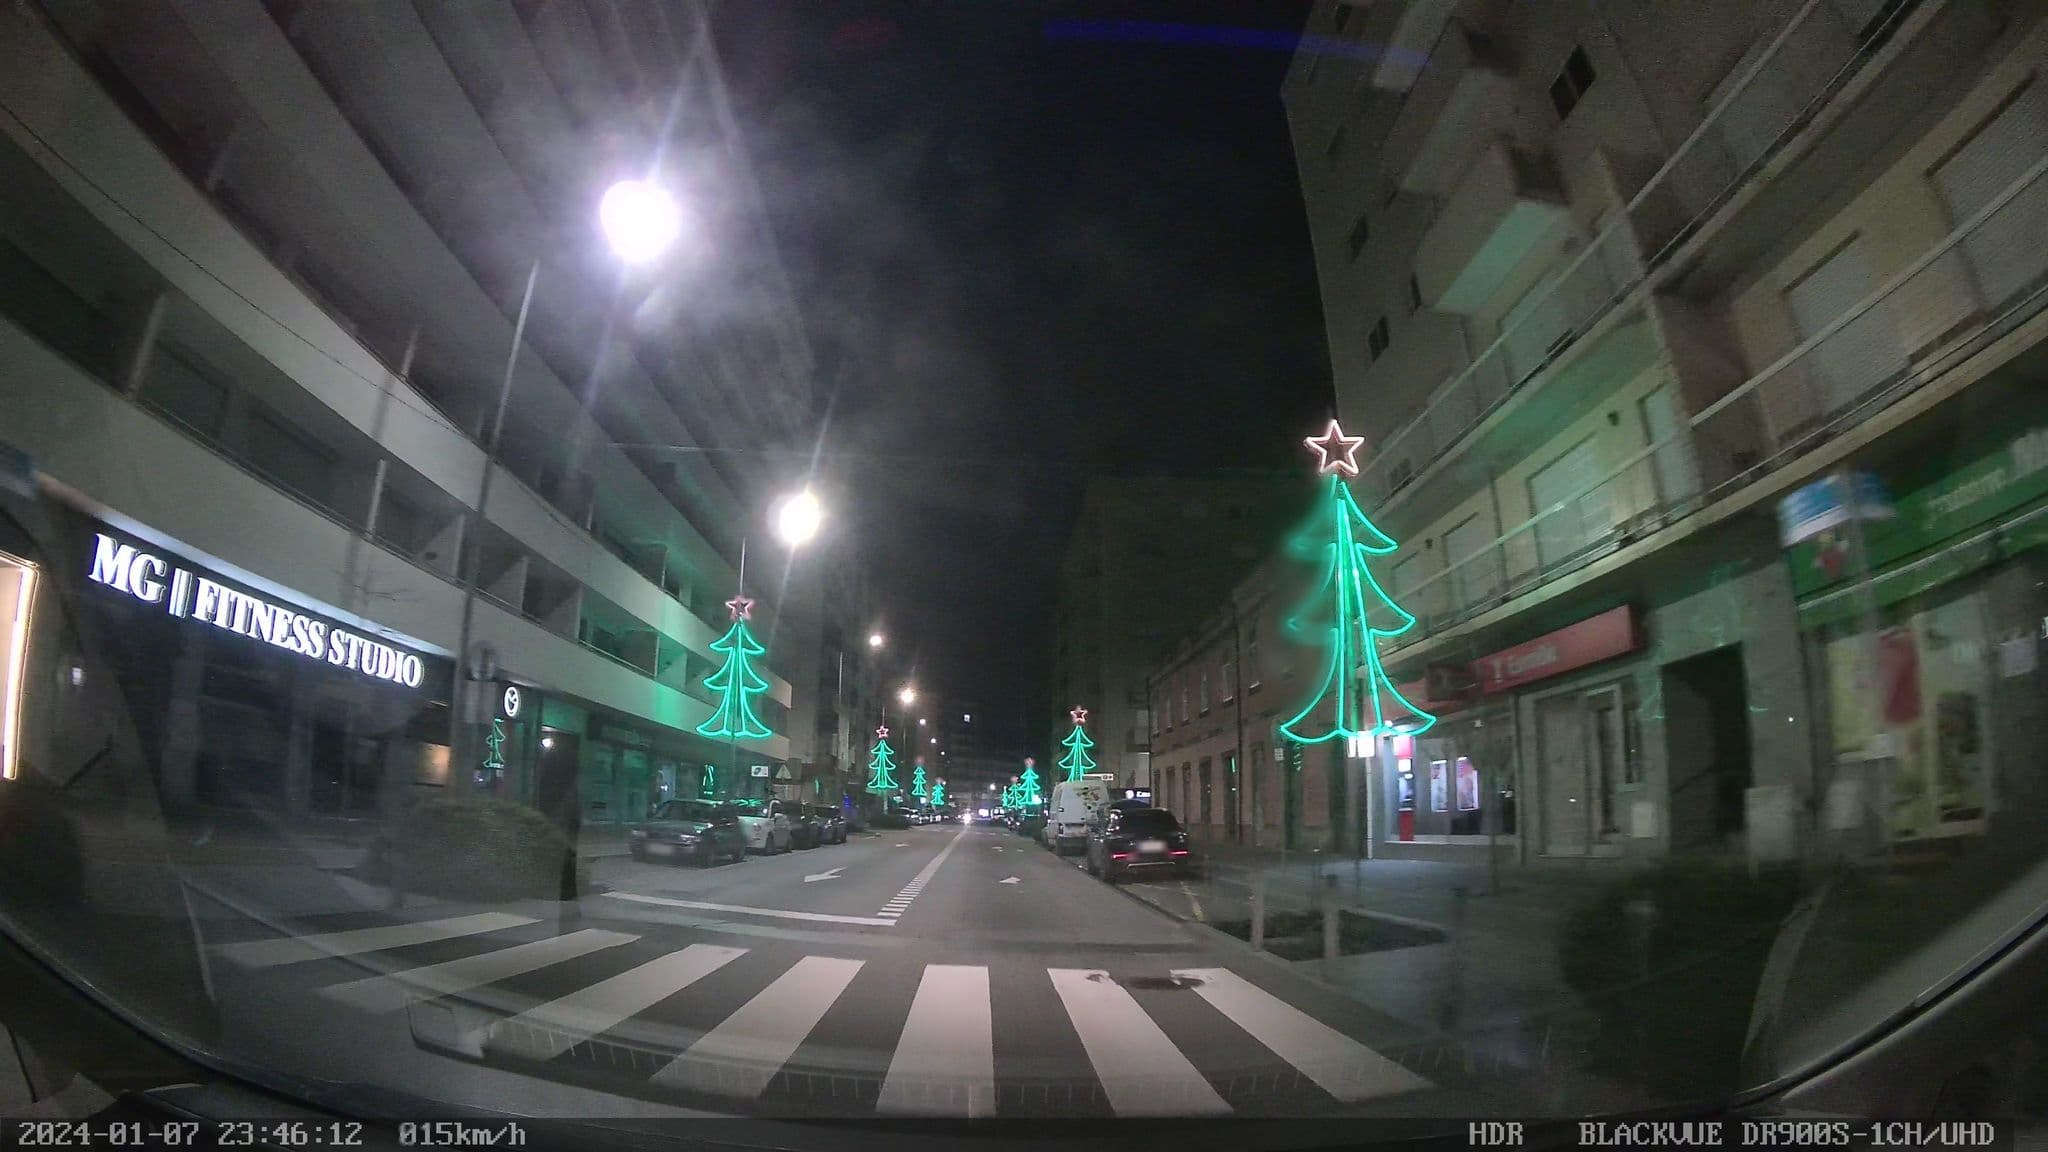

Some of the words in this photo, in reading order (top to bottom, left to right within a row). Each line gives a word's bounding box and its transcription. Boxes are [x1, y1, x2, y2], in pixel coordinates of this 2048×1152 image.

[88, 532, 167, 604] MG
[191, 576, 328, 660] FITNESS
[327, 628, 424, 689] STUDIO
